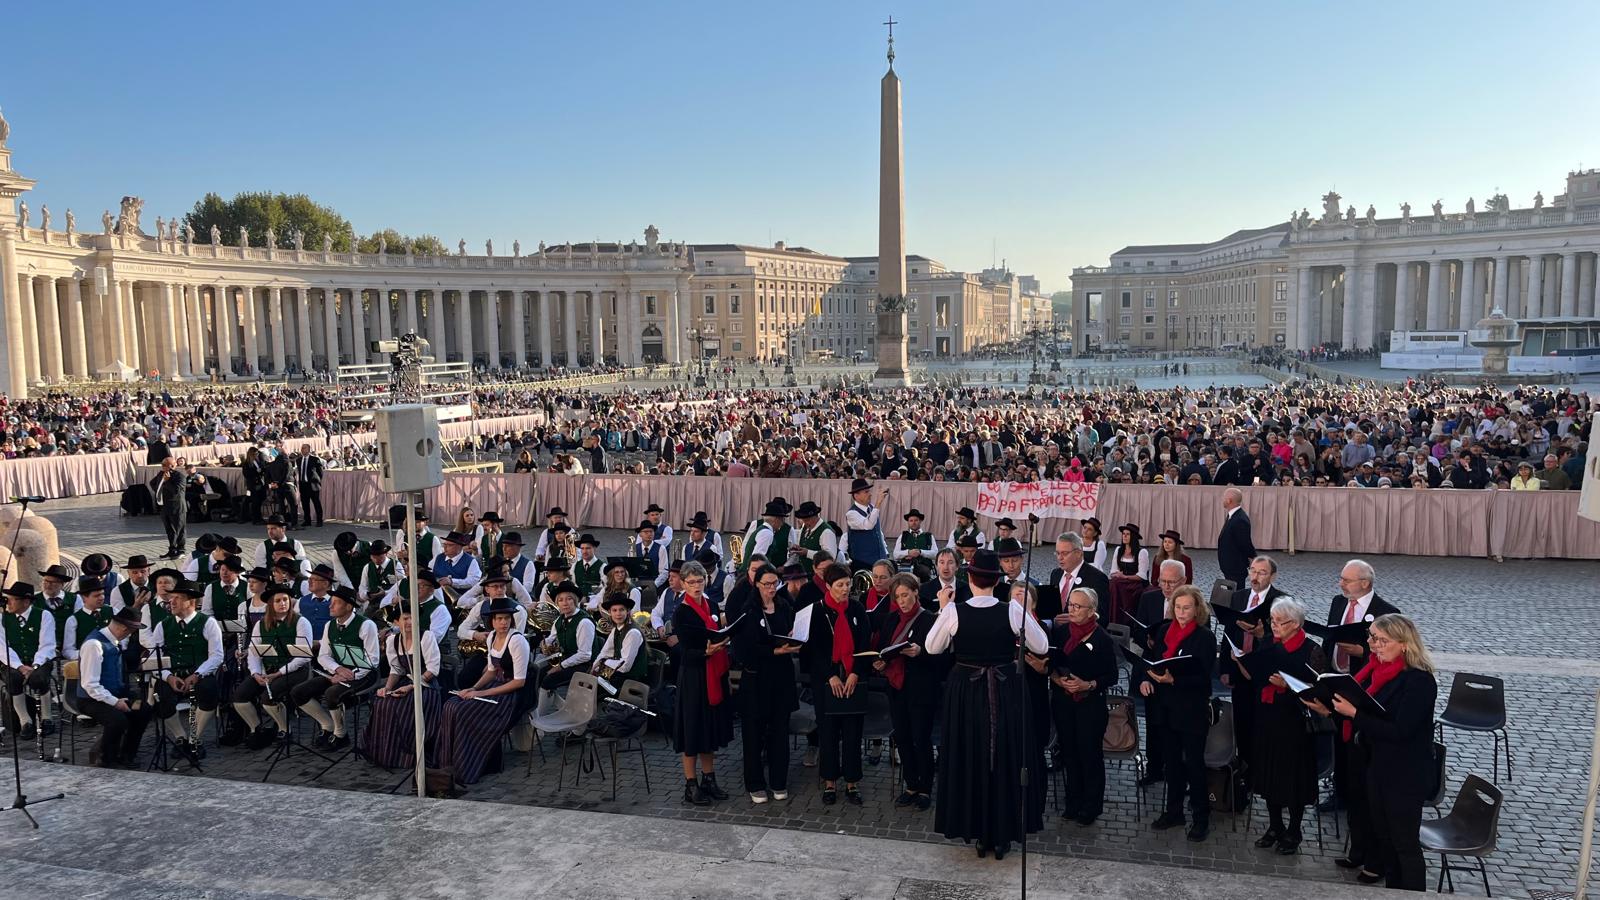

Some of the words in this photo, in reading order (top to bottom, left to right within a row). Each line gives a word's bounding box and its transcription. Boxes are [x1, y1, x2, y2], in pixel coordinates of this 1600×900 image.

[1008, 481, 1040, 492] SAN
[1050, 480, 1098, 495] LEONE
[1041, 487, 1049, 497] E
[978, 493, 1016, 512] PAPA
[1020, 494, 1096, 512] FRANCESCO
